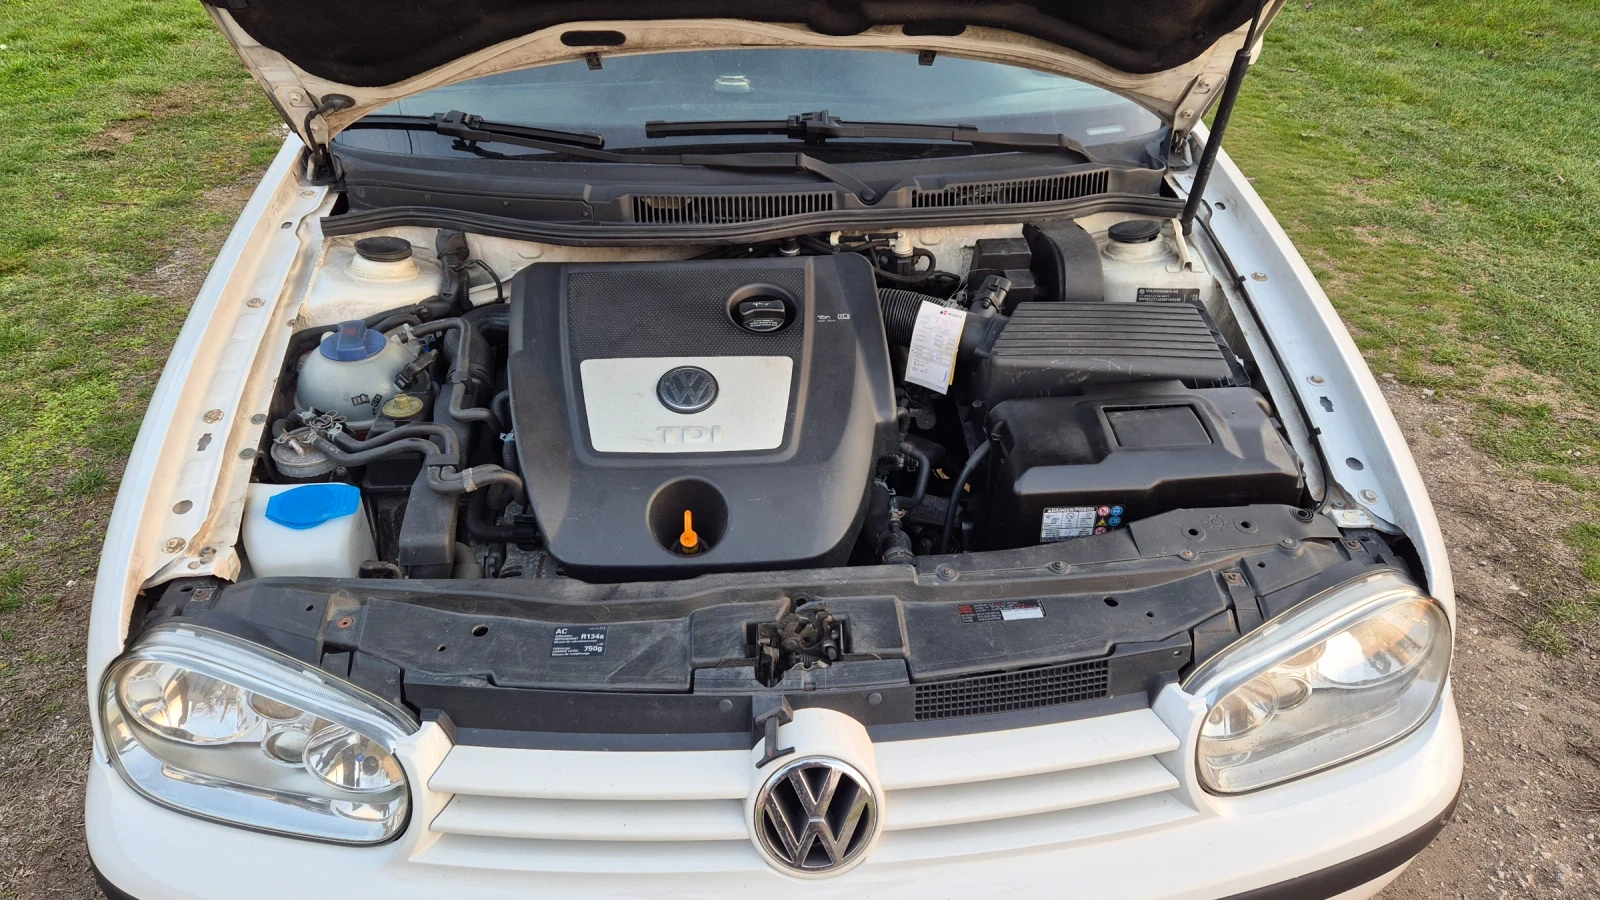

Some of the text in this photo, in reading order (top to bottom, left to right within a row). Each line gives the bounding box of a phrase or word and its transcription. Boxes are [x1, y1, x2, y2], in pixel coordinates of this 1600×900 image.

[656, 425, 723, 444] TDI
[584, 645, 603, 653] 750g
[755, 757, 877, 873] VW
